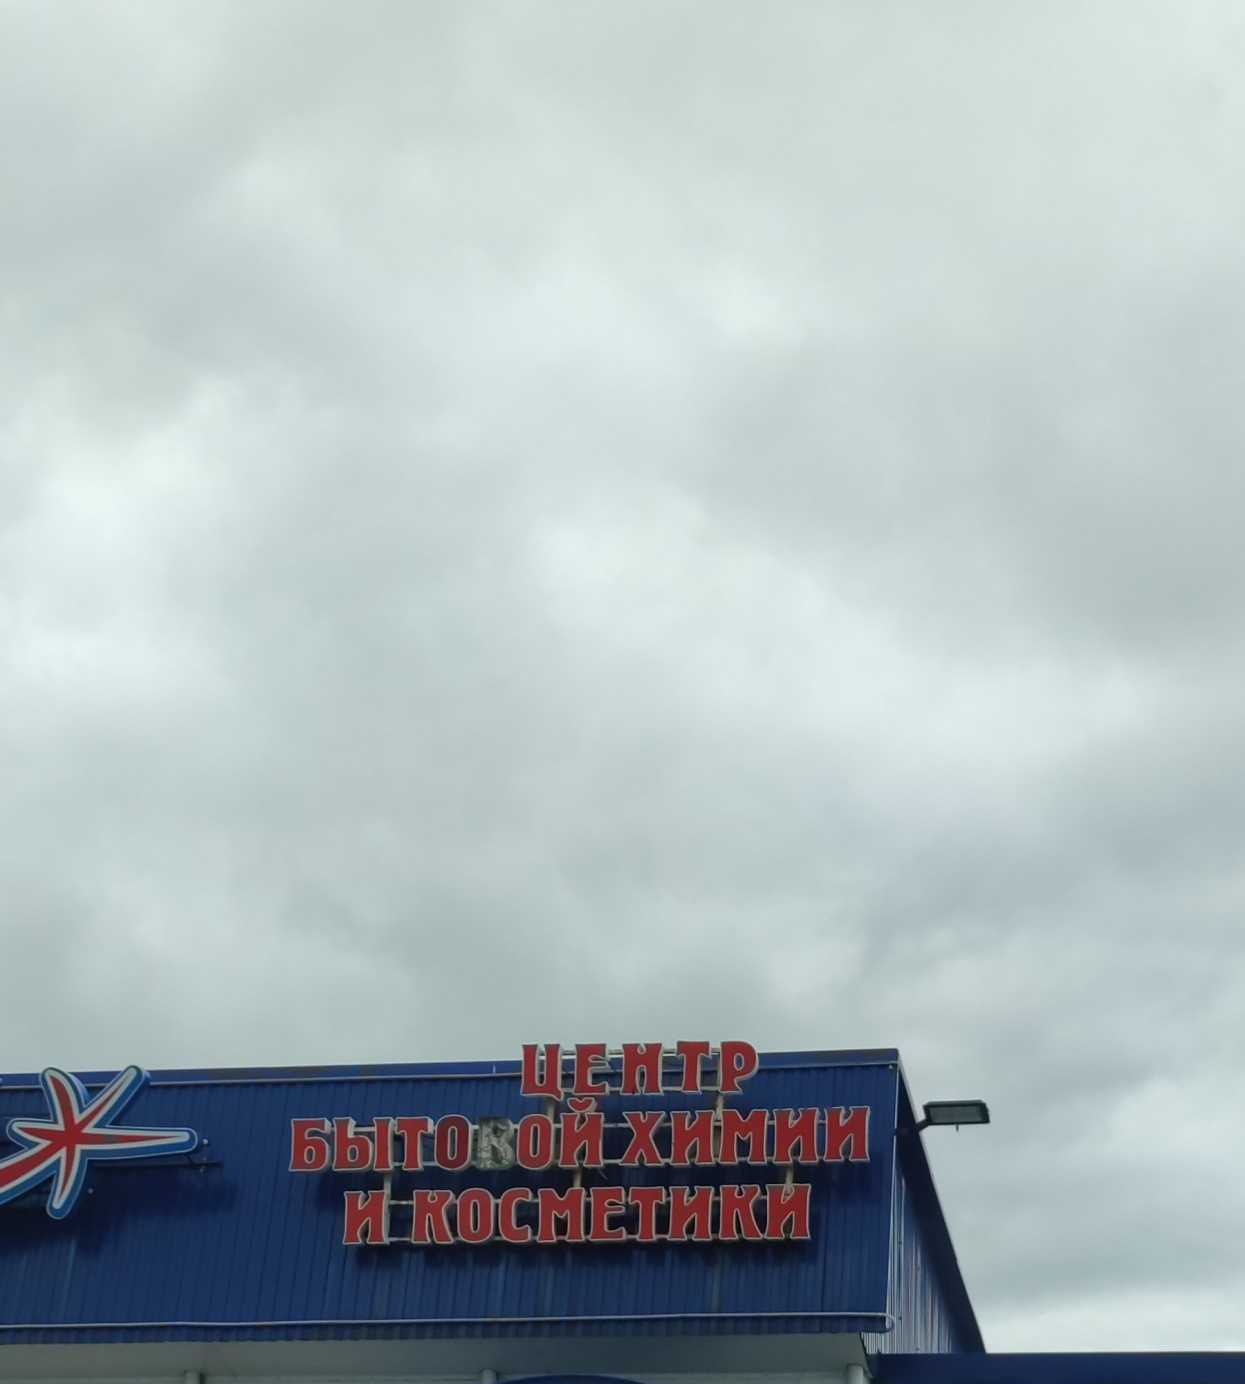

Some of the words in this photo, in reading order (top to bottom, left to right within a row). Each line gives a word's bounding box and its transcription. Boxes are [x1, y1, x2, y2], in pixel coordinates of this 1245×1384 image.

[521, 1040, 758, 1098] ЦЕНТР
[289, 1097, 604, 1171] БЫТОВОЙ
[622, 1106, 870, 1166] ХИМИИ
[342, 1189, 390, 1245] И
[411, 1183, 811, 1244] КОСМЕТИКИ
